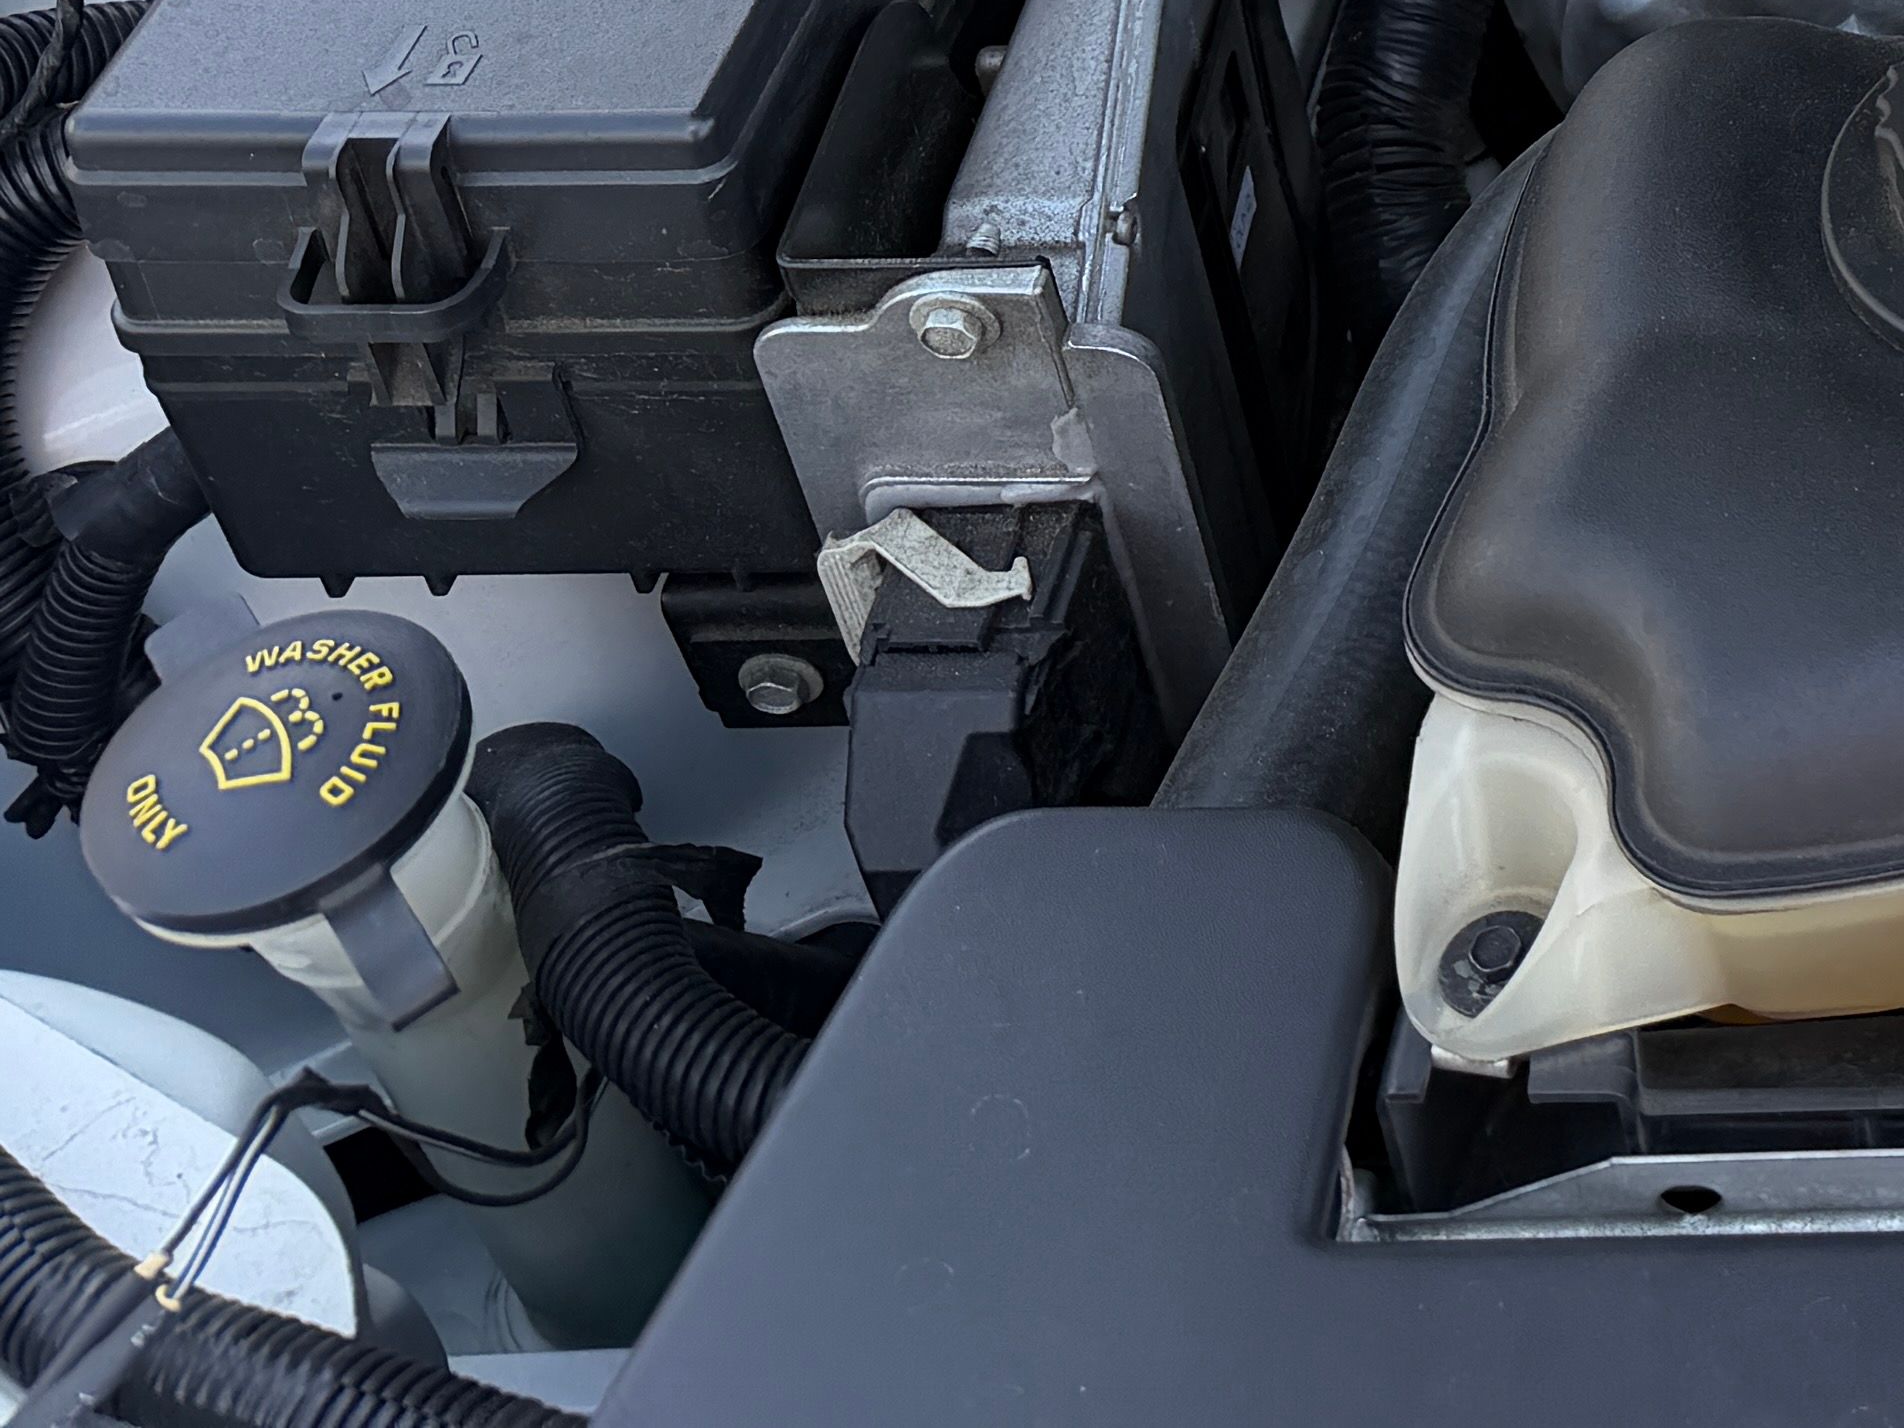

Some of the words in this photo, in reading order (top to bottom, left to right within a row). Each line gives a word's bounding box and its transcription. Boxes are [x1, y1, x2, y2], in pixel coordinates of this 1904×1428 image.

[245, 639, 394, 691] WASHER
[319, 701, 401, 808] FLUID
[126, 774, 188, 851] ONLY
